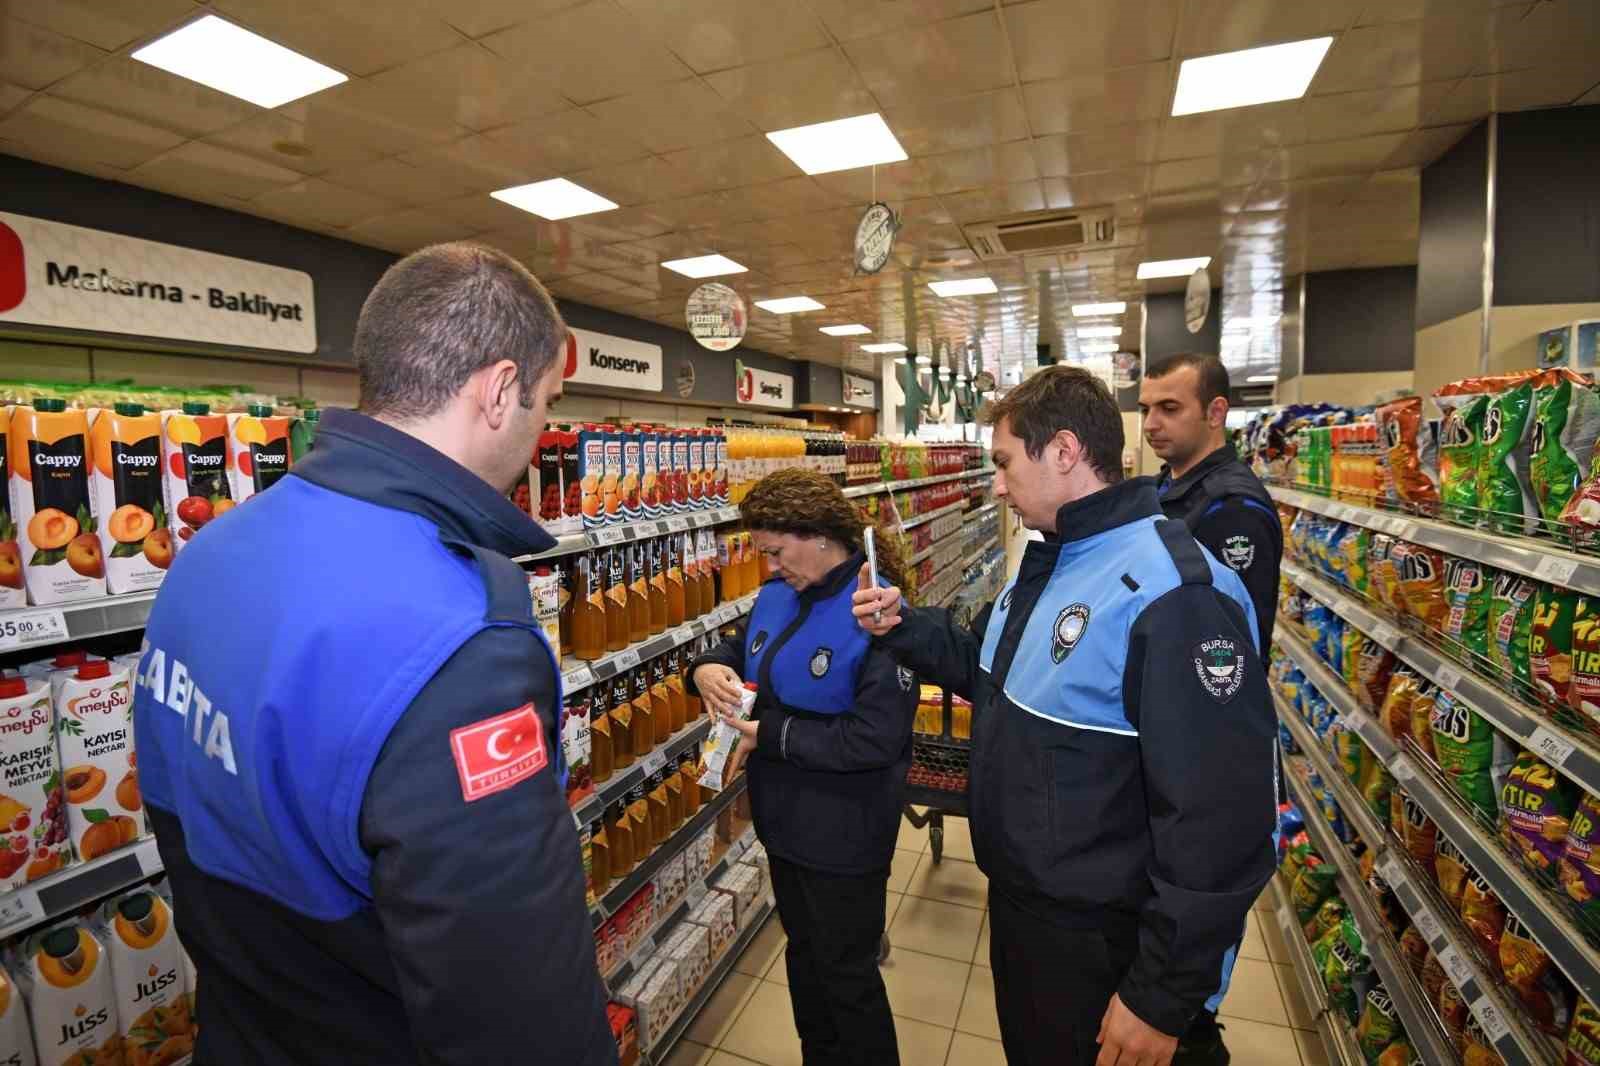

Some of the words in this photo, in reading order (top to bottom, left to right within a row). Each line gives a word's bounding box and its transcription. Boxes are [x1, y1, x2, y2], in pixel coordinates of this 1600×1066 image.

[45, 261, 184, 303] Makarna
[207, 287, 304, 322] Bakliyat
[589, 347, 651, 374] Konserve
[34, 453, 82, 468] Cappy
[116, 453, 158, 466] Cappy
[187, 454, 223, 466] Cappy
[254, 453, 286, 464] Cappy
[1200, 639, 1235, 653] BURSA
[83, 728, 127, 749] KAYISI
[0, 741, 54, 768] KARIŞIK
[87, 742, 126, 758] NEKTARI
[4, 758, 52, 780] MEYVE
[8, 770, 51, 789] NEKTARI
[132, 968, 178, 1003] Juss
[57, 1007, 109, 1047] Juss
